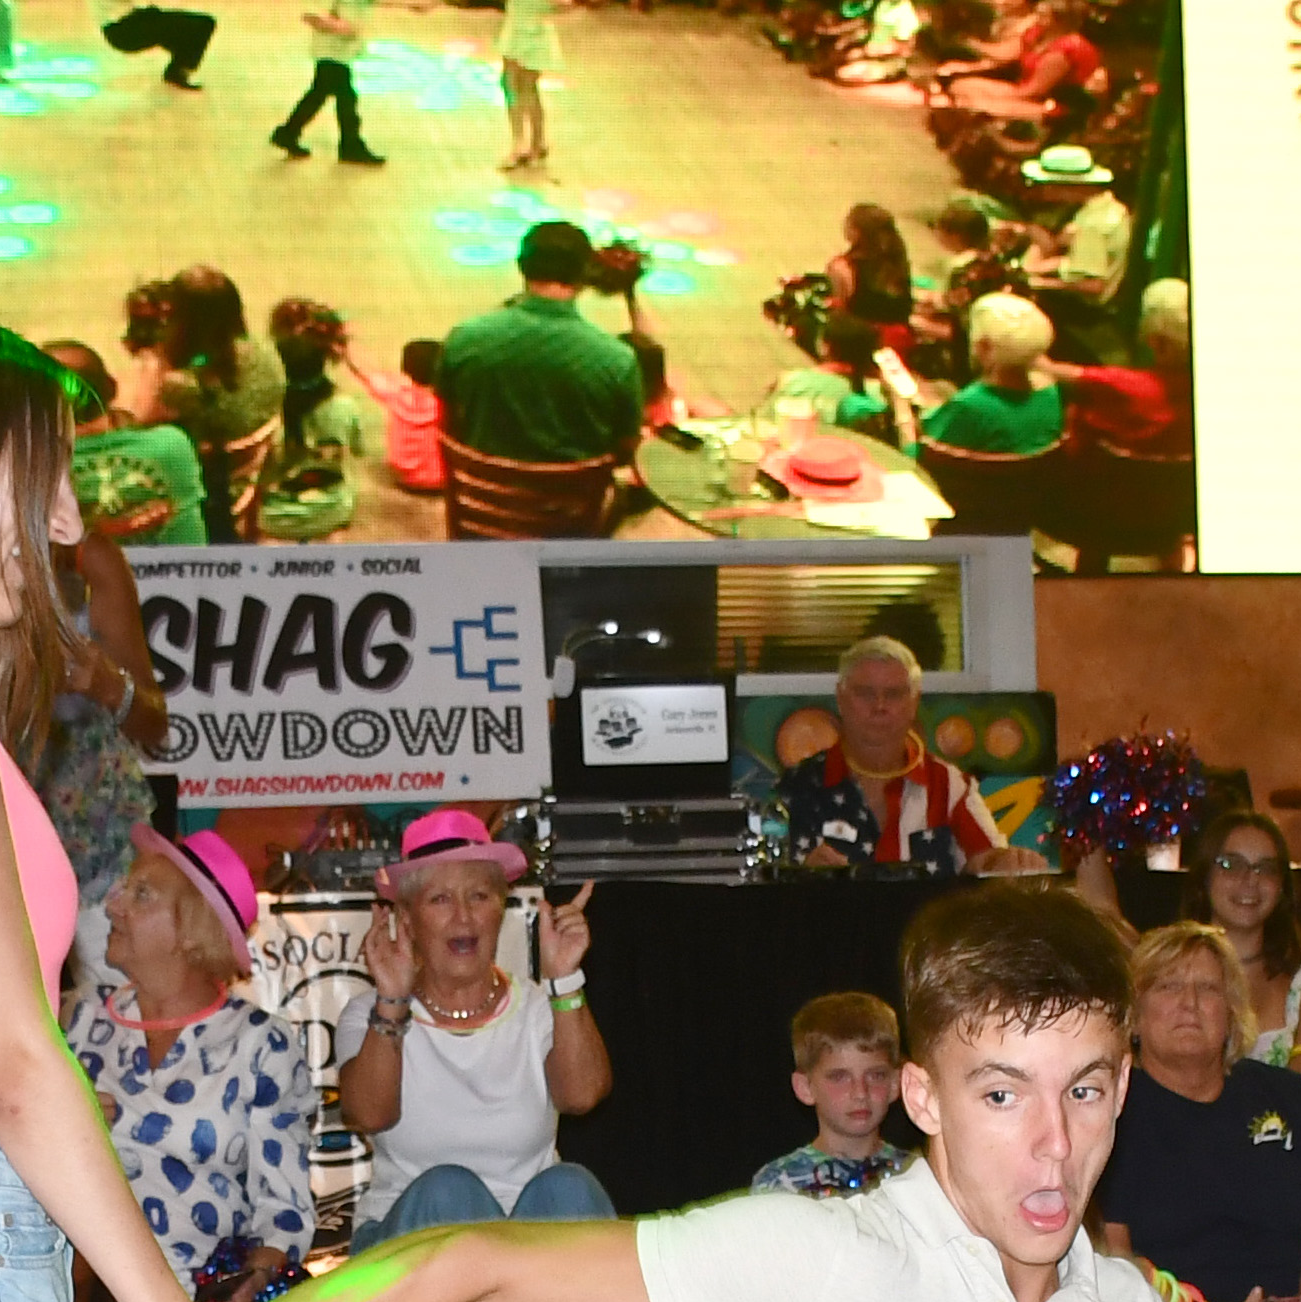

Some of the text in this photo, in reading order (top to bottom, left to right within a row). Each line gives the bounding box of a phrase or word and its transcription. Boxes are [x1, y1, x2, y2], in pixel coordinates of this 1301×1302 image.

[131, 557, 422, 580] OMPETITOR JUNIOR SOCIAL
[140, 591, 417, 698] SHAG
[141, 705, 525, 763] OWDOWN
